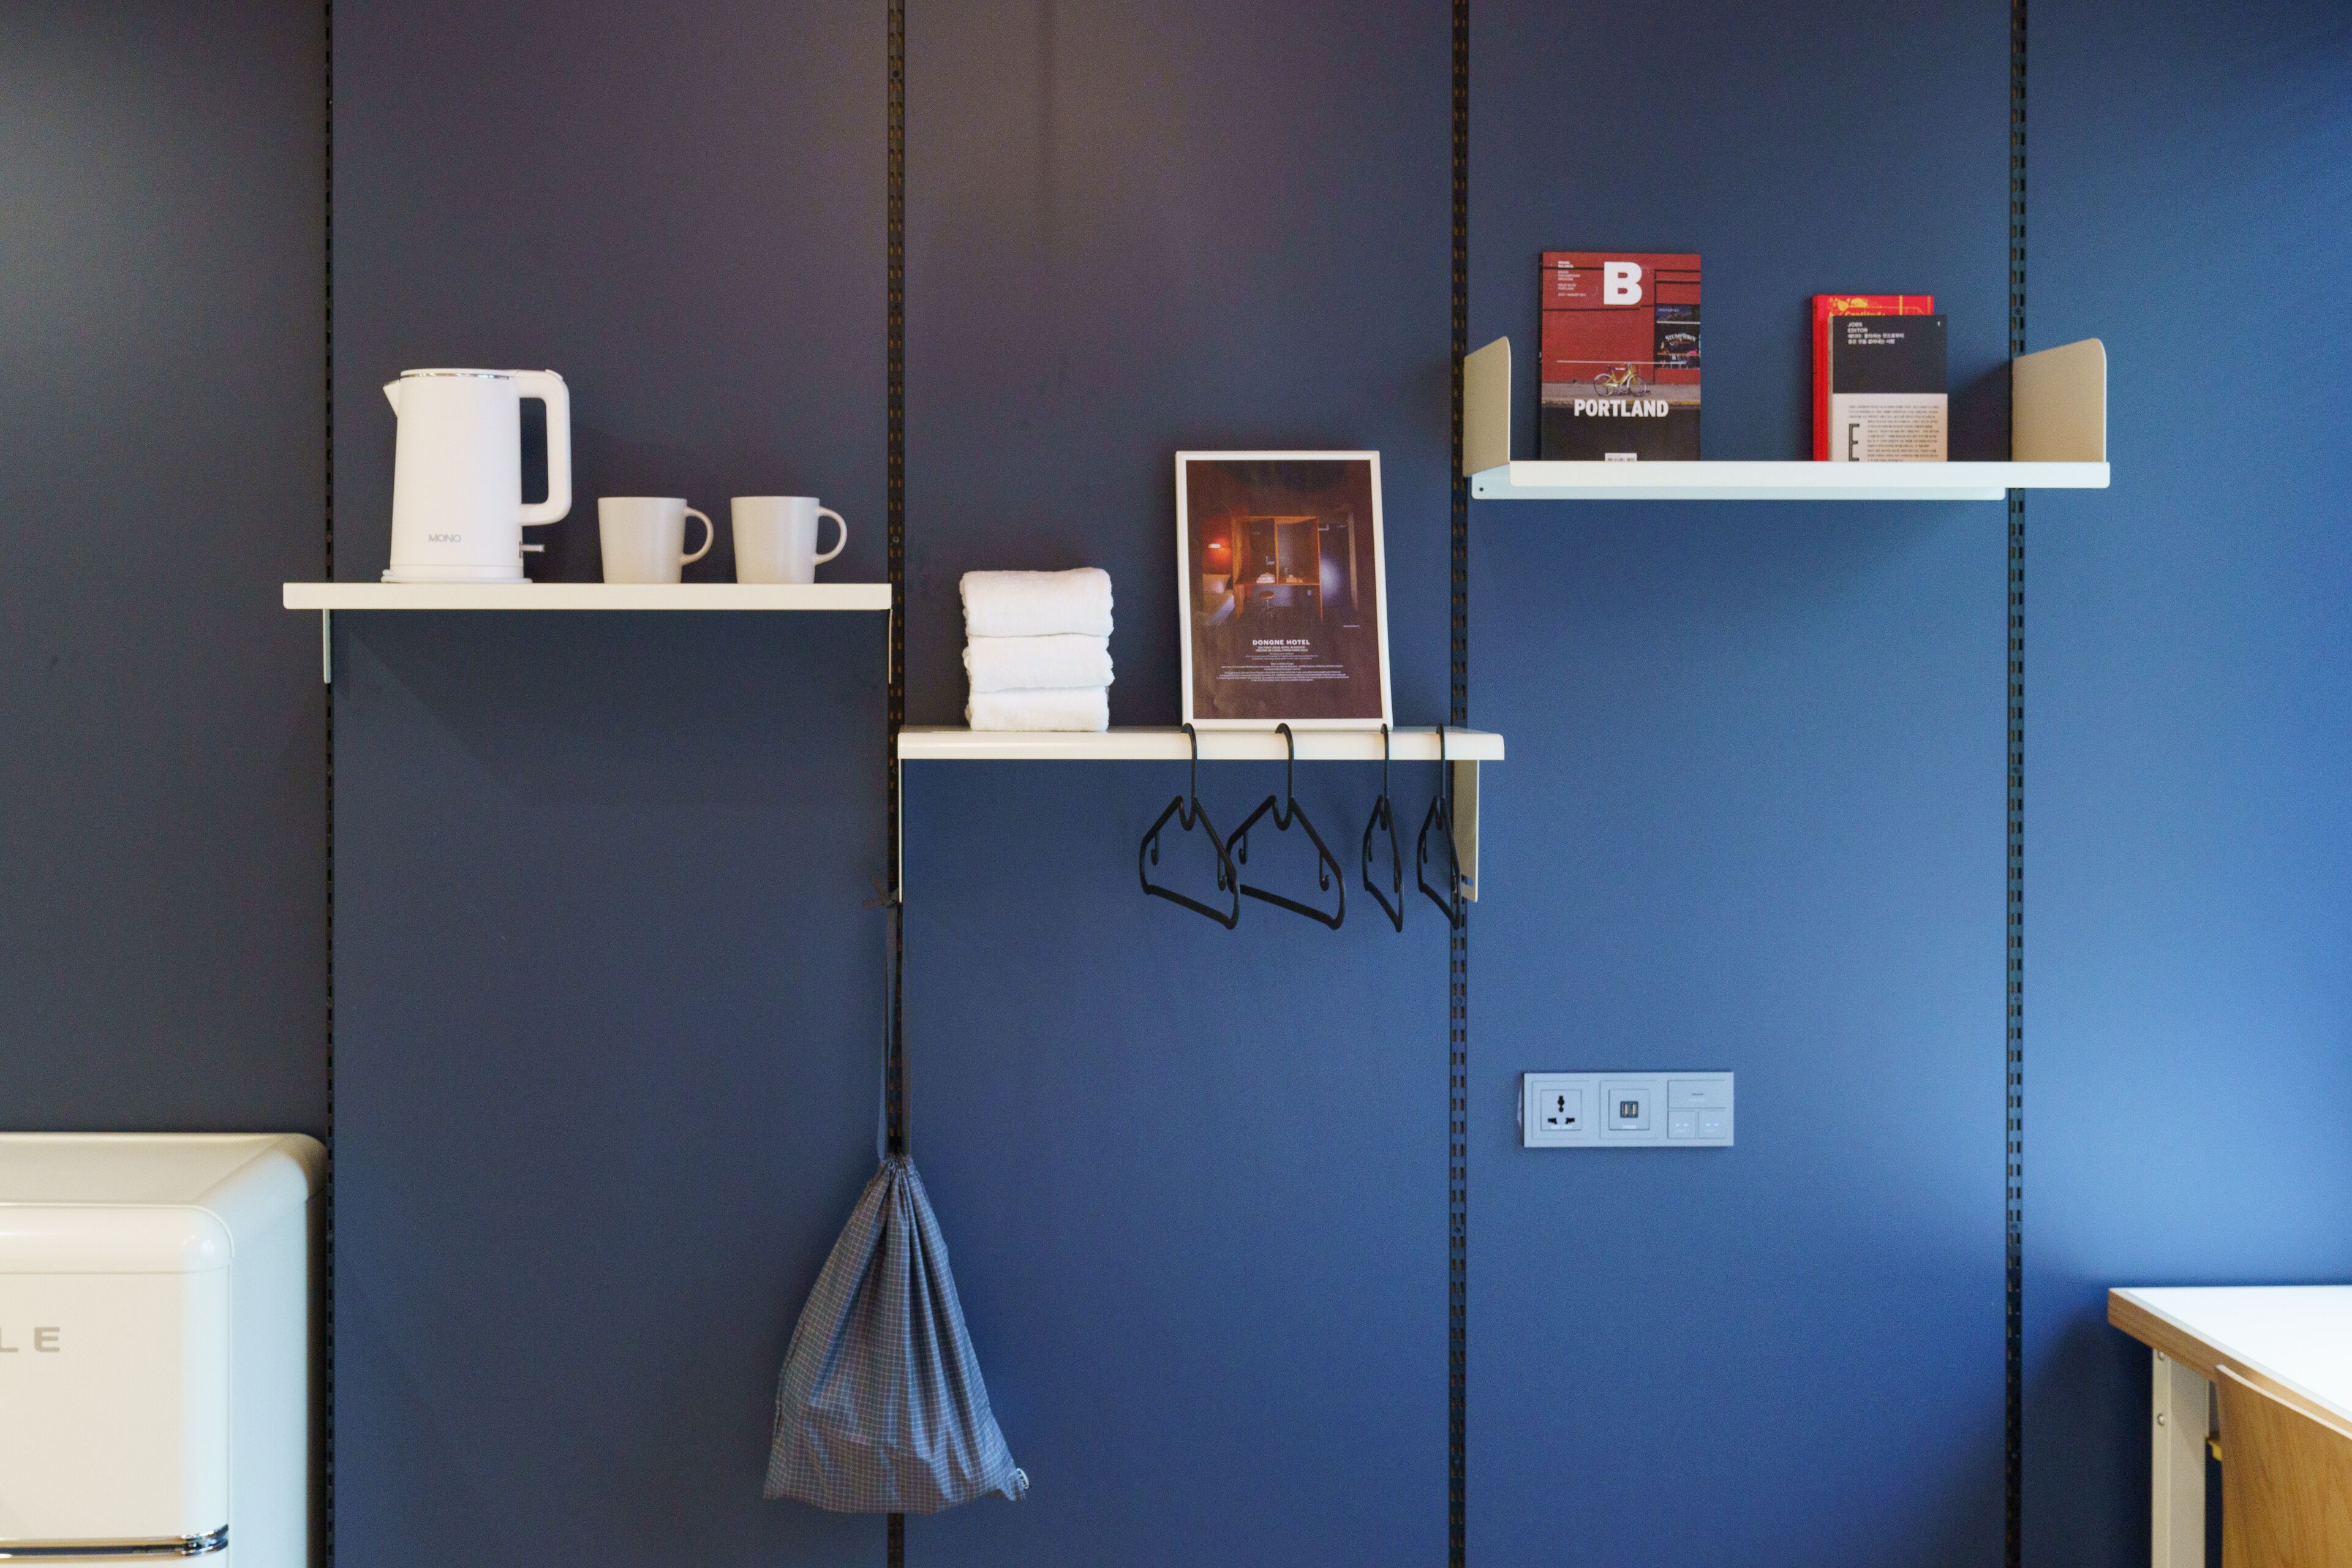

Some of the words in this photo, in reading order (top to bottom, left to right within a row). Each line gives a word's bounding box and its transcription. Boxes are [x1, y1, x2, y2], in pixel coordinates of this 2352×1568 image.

[1604, 262, 1643, 305] B
[1574, 399, 1669, 417] PORTLAND
[429, 534, 461, 543] MONO
